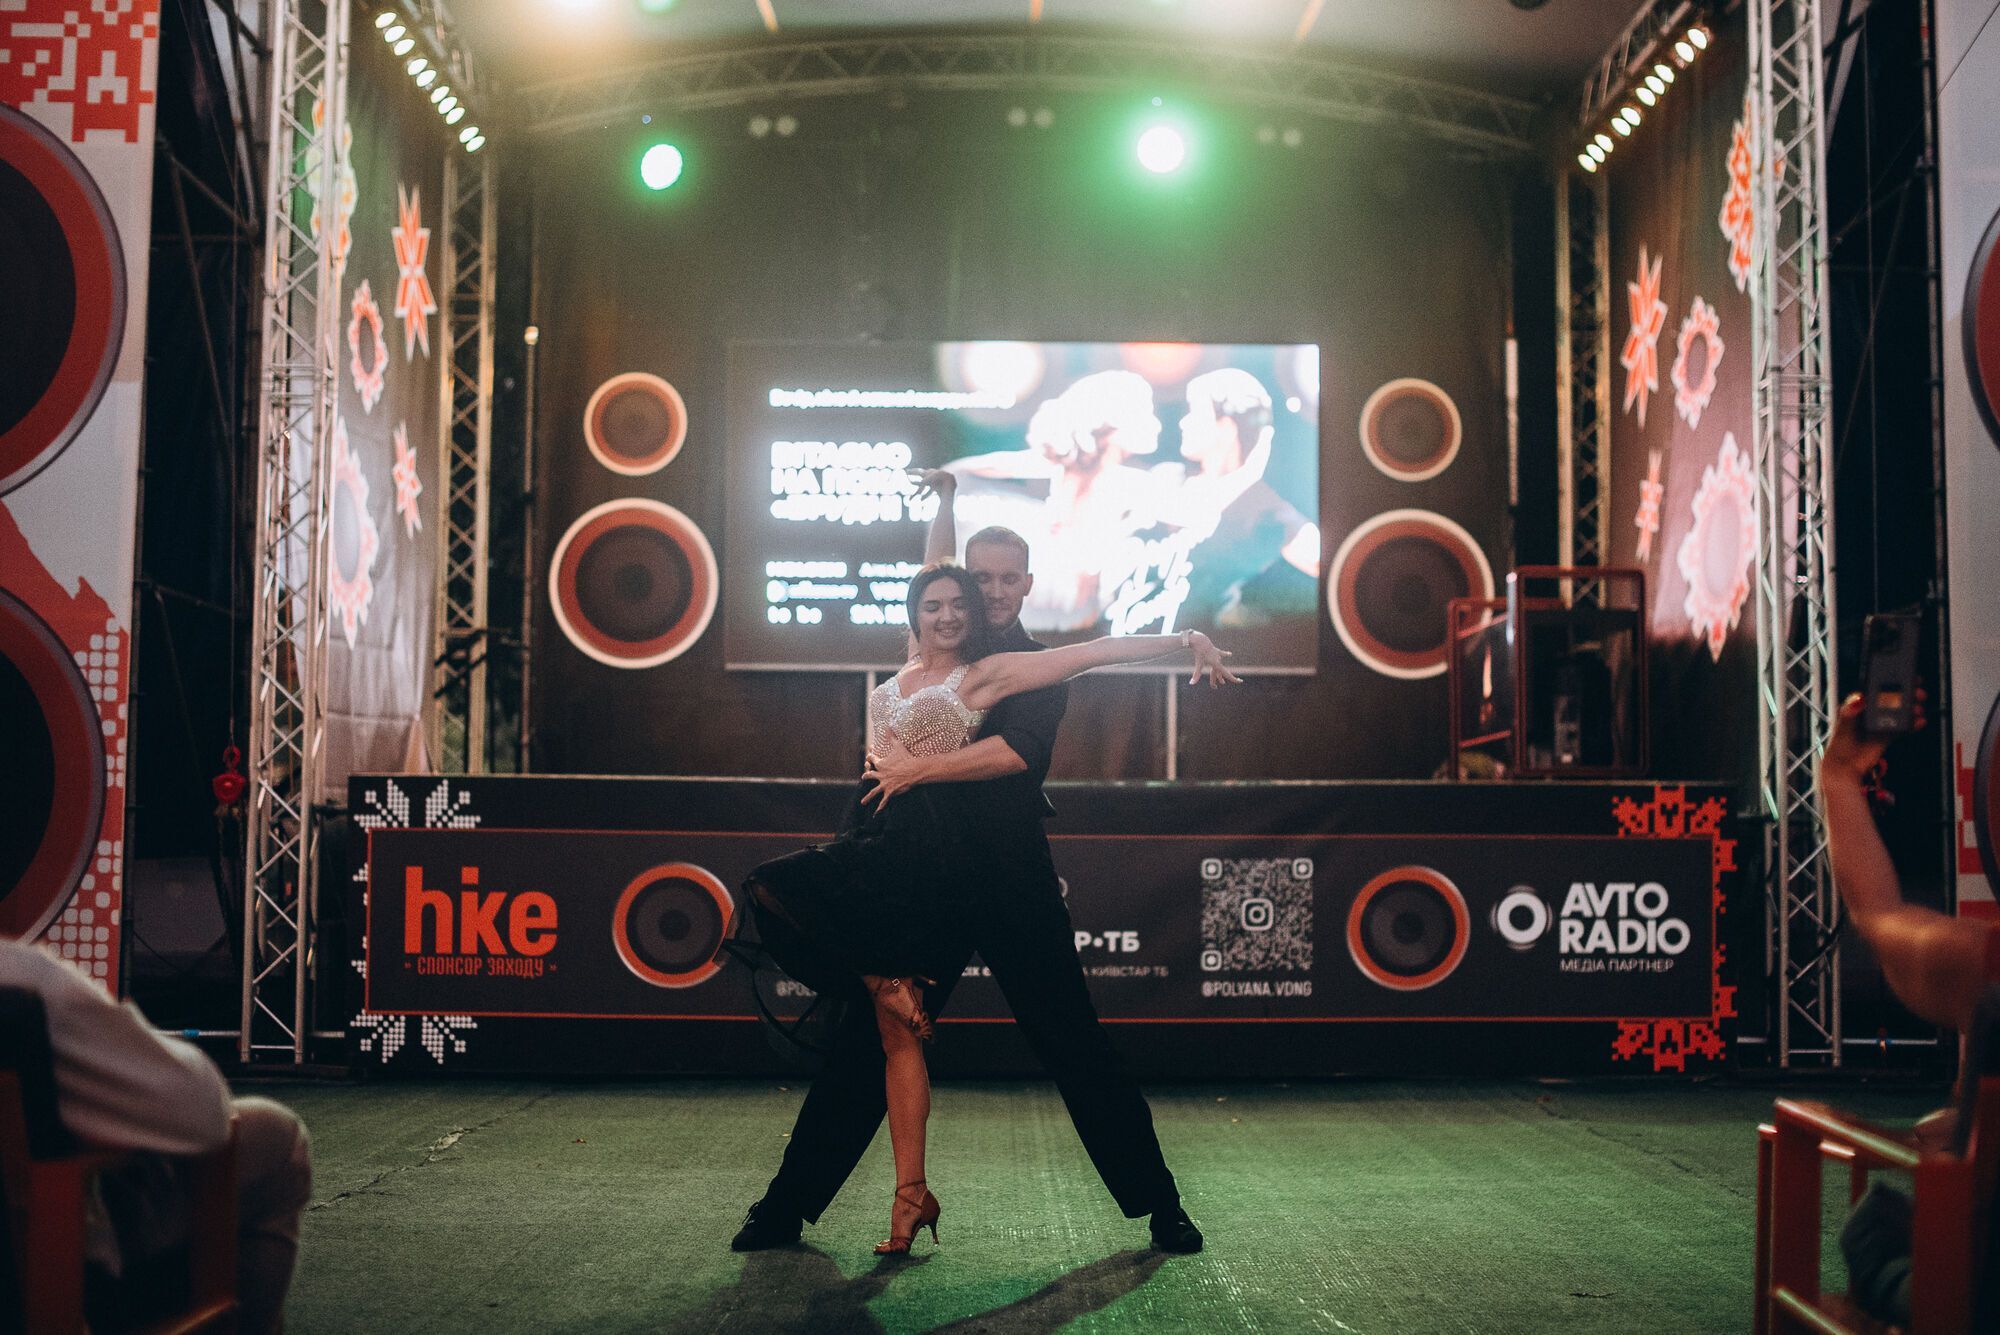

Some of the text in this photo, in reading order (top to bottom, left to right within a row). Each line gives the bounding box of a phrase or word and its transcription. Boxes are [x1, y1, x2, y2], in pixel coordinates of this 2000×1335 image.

[404, 866, 558, 956] hike
[1559, 881, 1669, 919] AVTO
[1559, 917, 1691, 955] RADIO
[417, 956, 544, 979] СПОНСОР ЗАХОДУ
[1560, 958, 1675, 973] МЕДІА ПАРТНЕР
[1202, 980, 1313, 997] @POLYANA.VDNG
